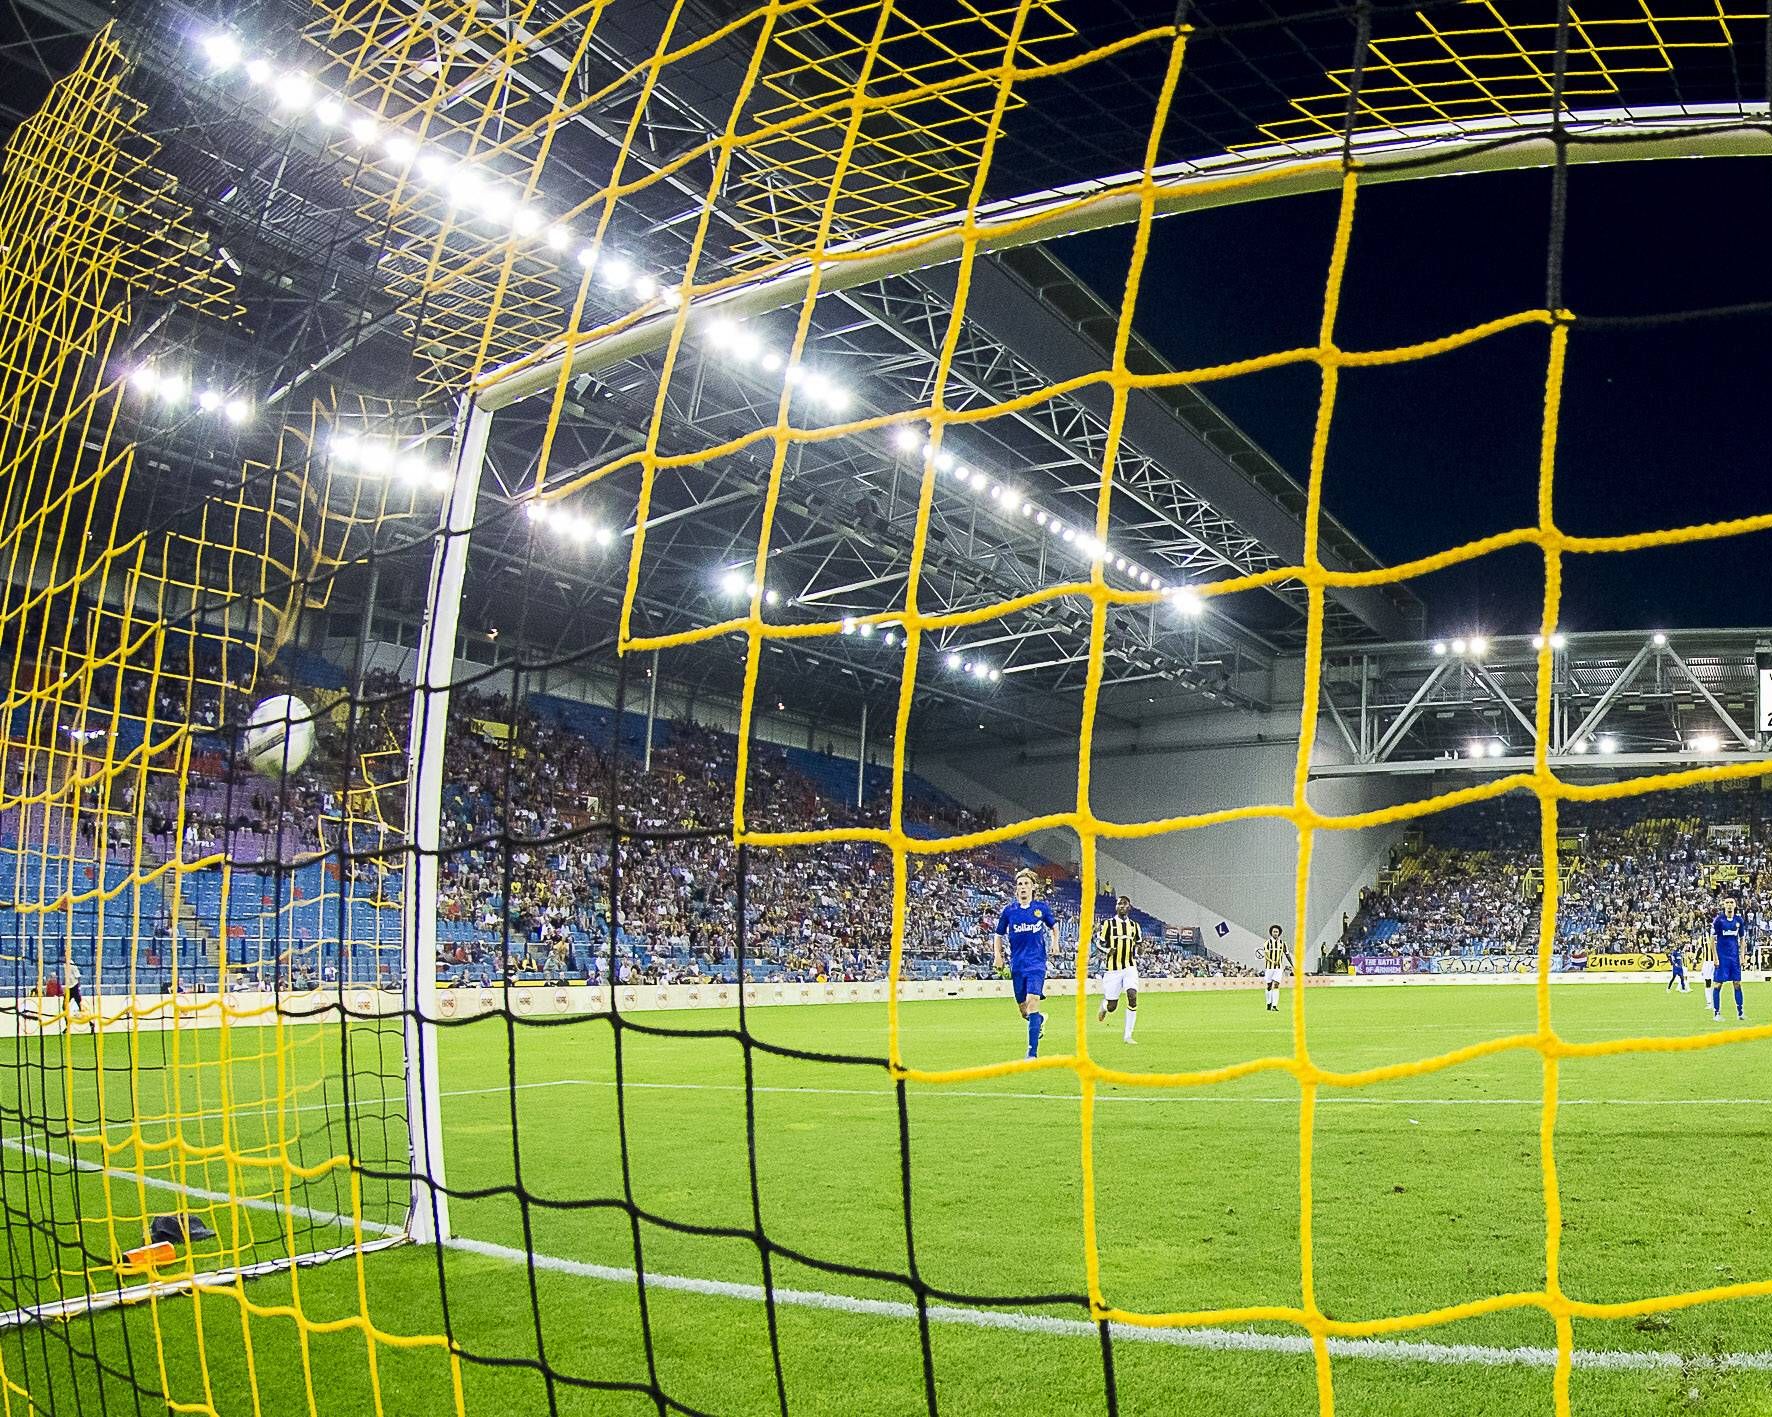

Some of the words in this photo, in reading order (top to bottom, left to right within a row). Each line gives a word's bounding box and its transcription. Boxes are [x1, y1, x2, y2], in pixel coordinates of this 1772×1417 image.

[1365, 958, 1377, 966] THE
[1377, 958, 1401, 966] BATTLE
[1365, 966, 1374, 974] OF
